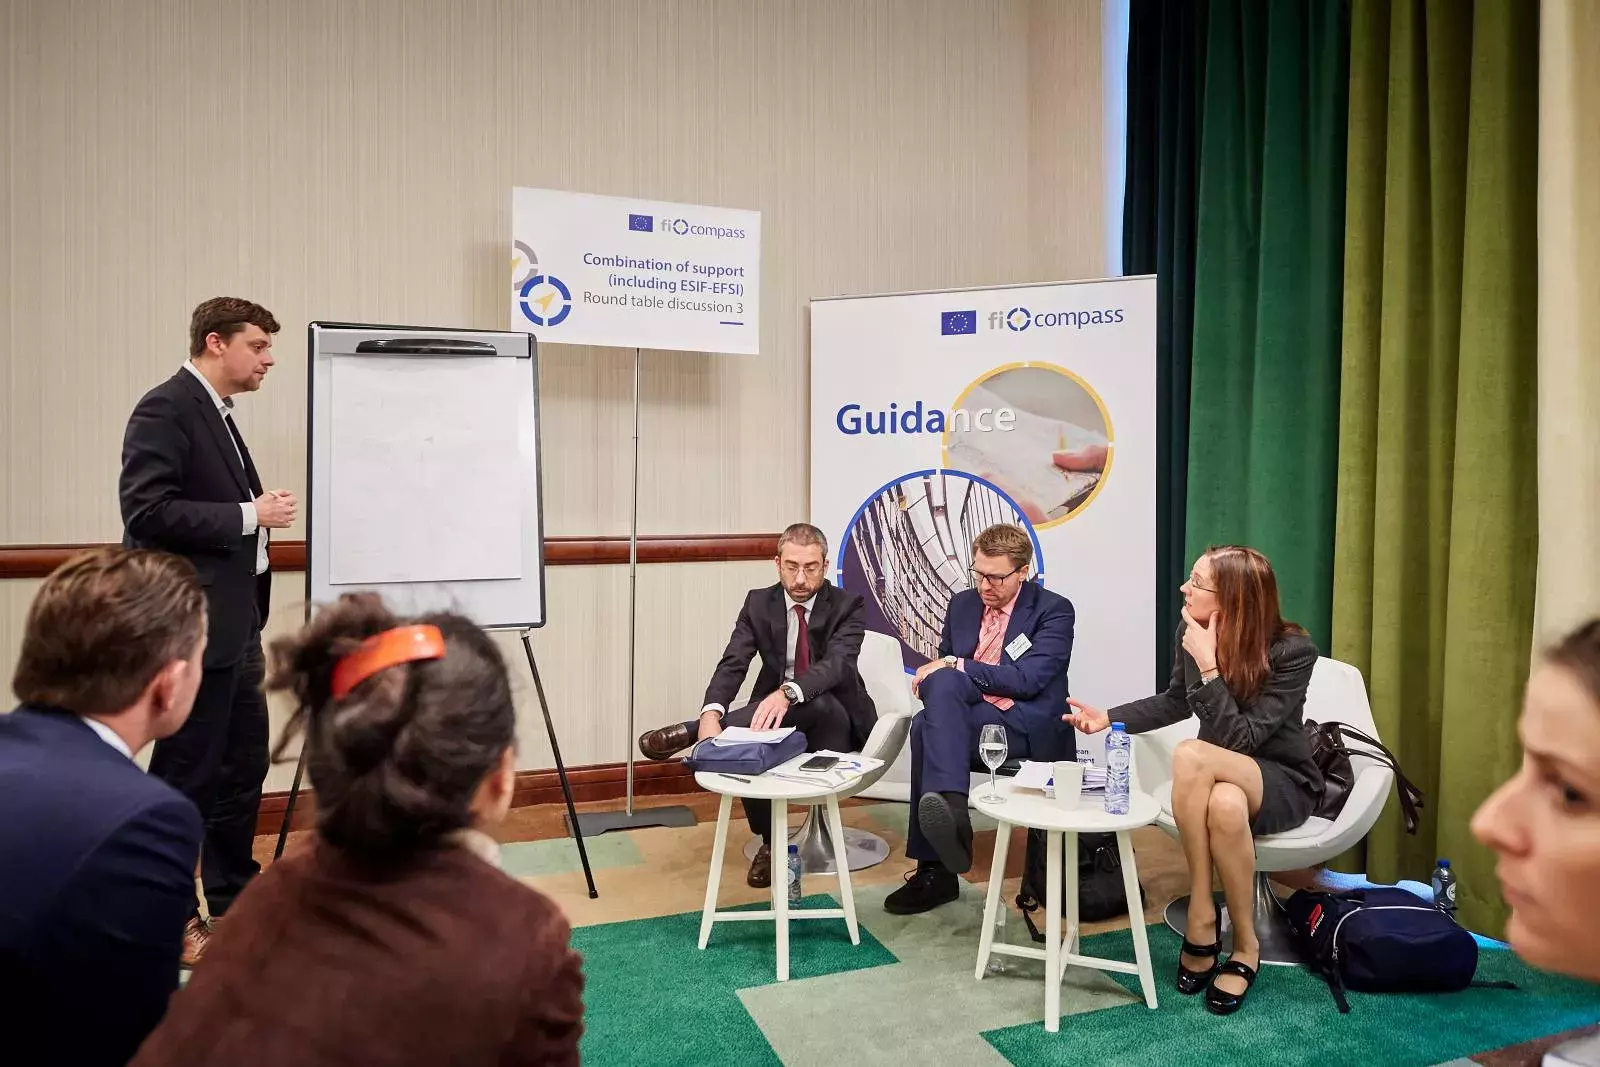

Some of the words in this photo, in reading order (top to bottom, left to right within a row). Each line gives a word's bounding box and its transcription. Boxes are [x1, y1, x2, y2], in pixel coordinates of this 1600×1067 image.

[690, 224, 746, 240] compass
[583, 252, 672, 272] Combination
[675, 260, 690, 273] of
[692, 264, 745, 278] support
[608, 273, 677, 294] (including
[680, 279, 744, 298] ESIF-EFSI)
[583, 290, 628, 306] Round
[630, 295, 664, 309] table
[667, 296, 733, 313] discussion
[736, 302, 744, 314] 3
[1034, 308, 1124, 330] compass
[836, 400, 1016, 436] Guidance
